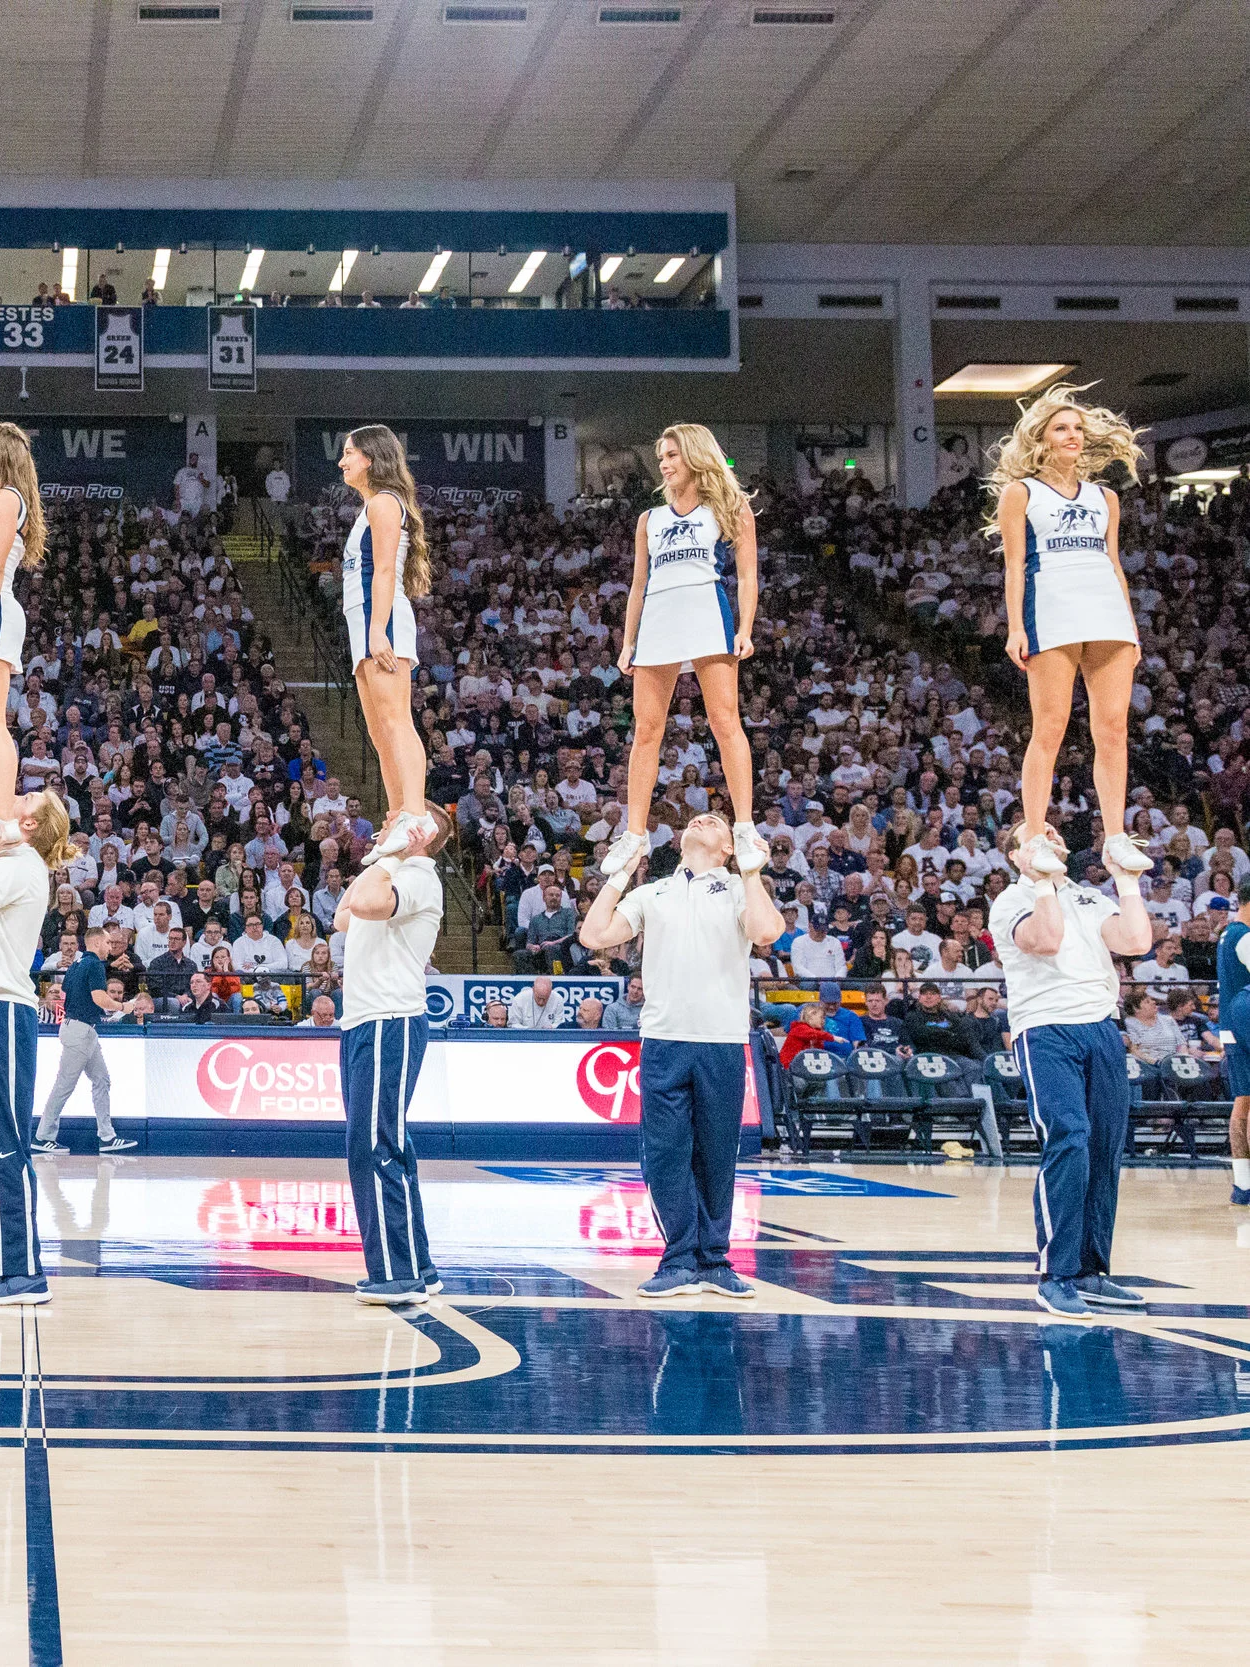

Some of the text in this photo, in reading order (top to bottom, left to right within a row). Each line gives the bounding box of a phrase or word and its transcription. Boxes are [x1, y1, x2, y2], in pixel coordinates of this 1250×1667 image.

[3, 322, 44, 348] 33
[104, 345, 135, 364] 24
[219, 345, 245, 364] 31
[195, 421, 209, 436] A
[554, 424, 568, 439] B
[914, 427, 927, 442] C
[62, 429, 127, 458] WE
[443, 432, 524, 462] WIN
[39, 483, 124, 501] Sign Pro
[437, 487, 482, 503] Sign
[1047, 536, 1105, 551] UTAH STATE
[654, 548, 708, 569] UTAH STATE
[468, 986, 514, 1004] CBS
[207, 1043, 342, 1114] Gossn
[260, 1097, 342, 1112] FOOD
